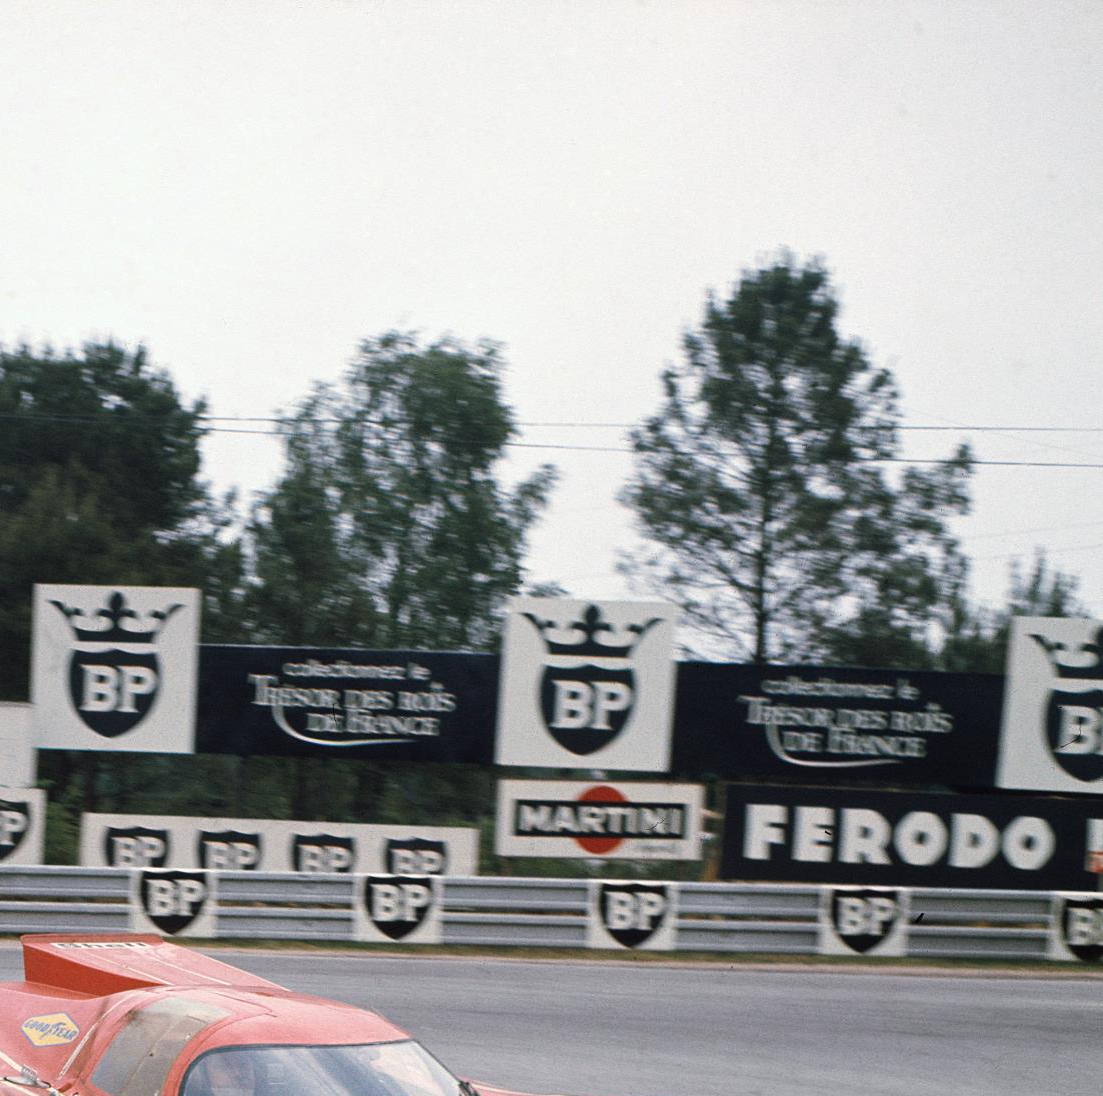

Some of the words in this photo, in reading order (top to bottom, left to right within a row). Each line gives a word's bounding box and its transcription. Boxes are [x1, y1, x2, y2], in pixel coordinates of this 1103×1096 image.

[81, 664, 157, 713] BP
[343, 688, 395, 710] DES
[550, 680, 632, 731] BP
[305, 712, 344, 734] DE
[345, 707, 441, 737] FRANCE
[835, 707, 890, 731] DES
[1057, 704, 1103, 755] B
[782, 730, 824, 753] DE
[826, 725, 928, 758] FRANCE
[518, 804, 684, 836] MARTINI
[742, 803, 1057, 871] FERODO
[110, 836, 167, 867] BP
[204, 840, 259, 869] BP
[297, 844, 354, 872] BP
[391, 848, 445, 874] BP
[145, 878, 207, 917] BP
[371, 882, 431, 922] BP
[604, 892, 666, 932] BP
[836, 897, 895, 938] BP
[1065, 908, 1103, 947] B
